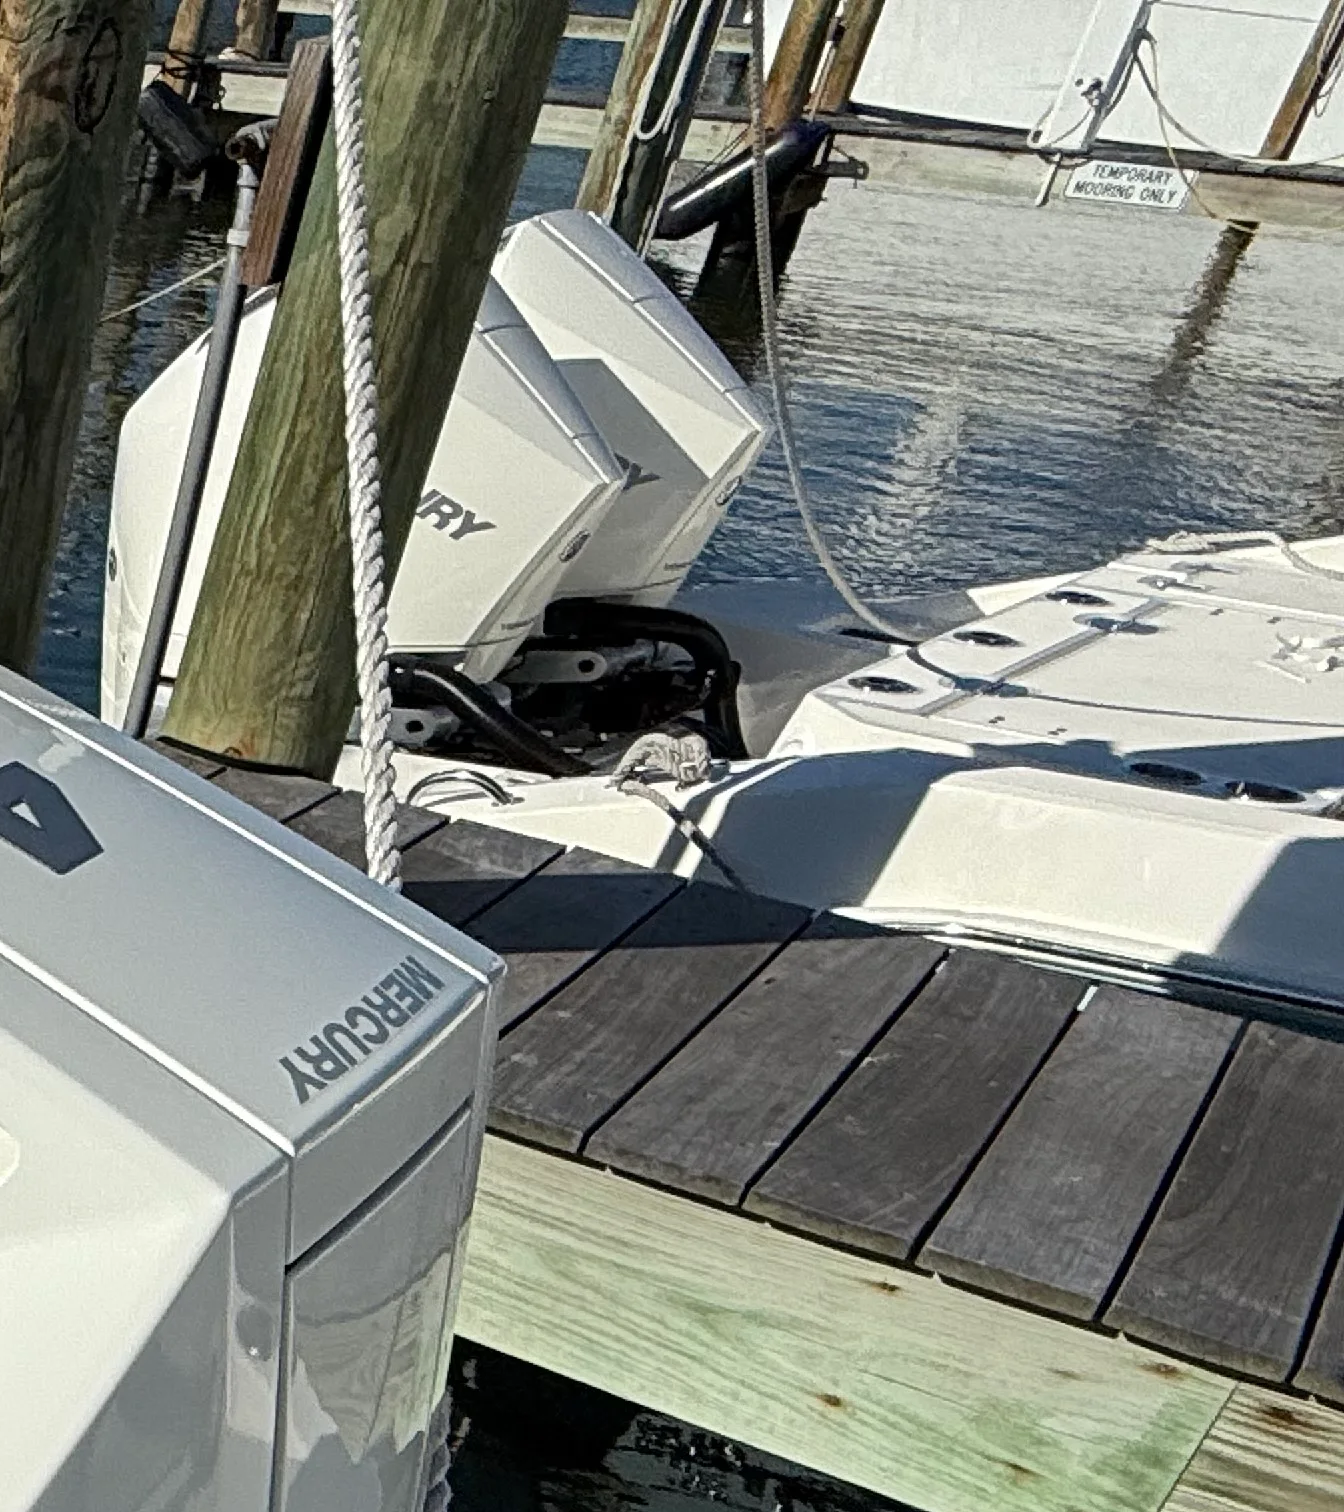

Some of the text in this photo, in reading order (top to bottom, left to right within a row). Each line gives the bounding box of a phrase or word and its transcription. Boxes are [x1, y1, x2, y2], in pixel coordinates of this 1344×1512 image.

[1093, 164, 1175, 185] TEMPORARY
[1072, 181, 1178, 204] MOORING ONLY
[278, 954, 446, 1105] MERCURY
